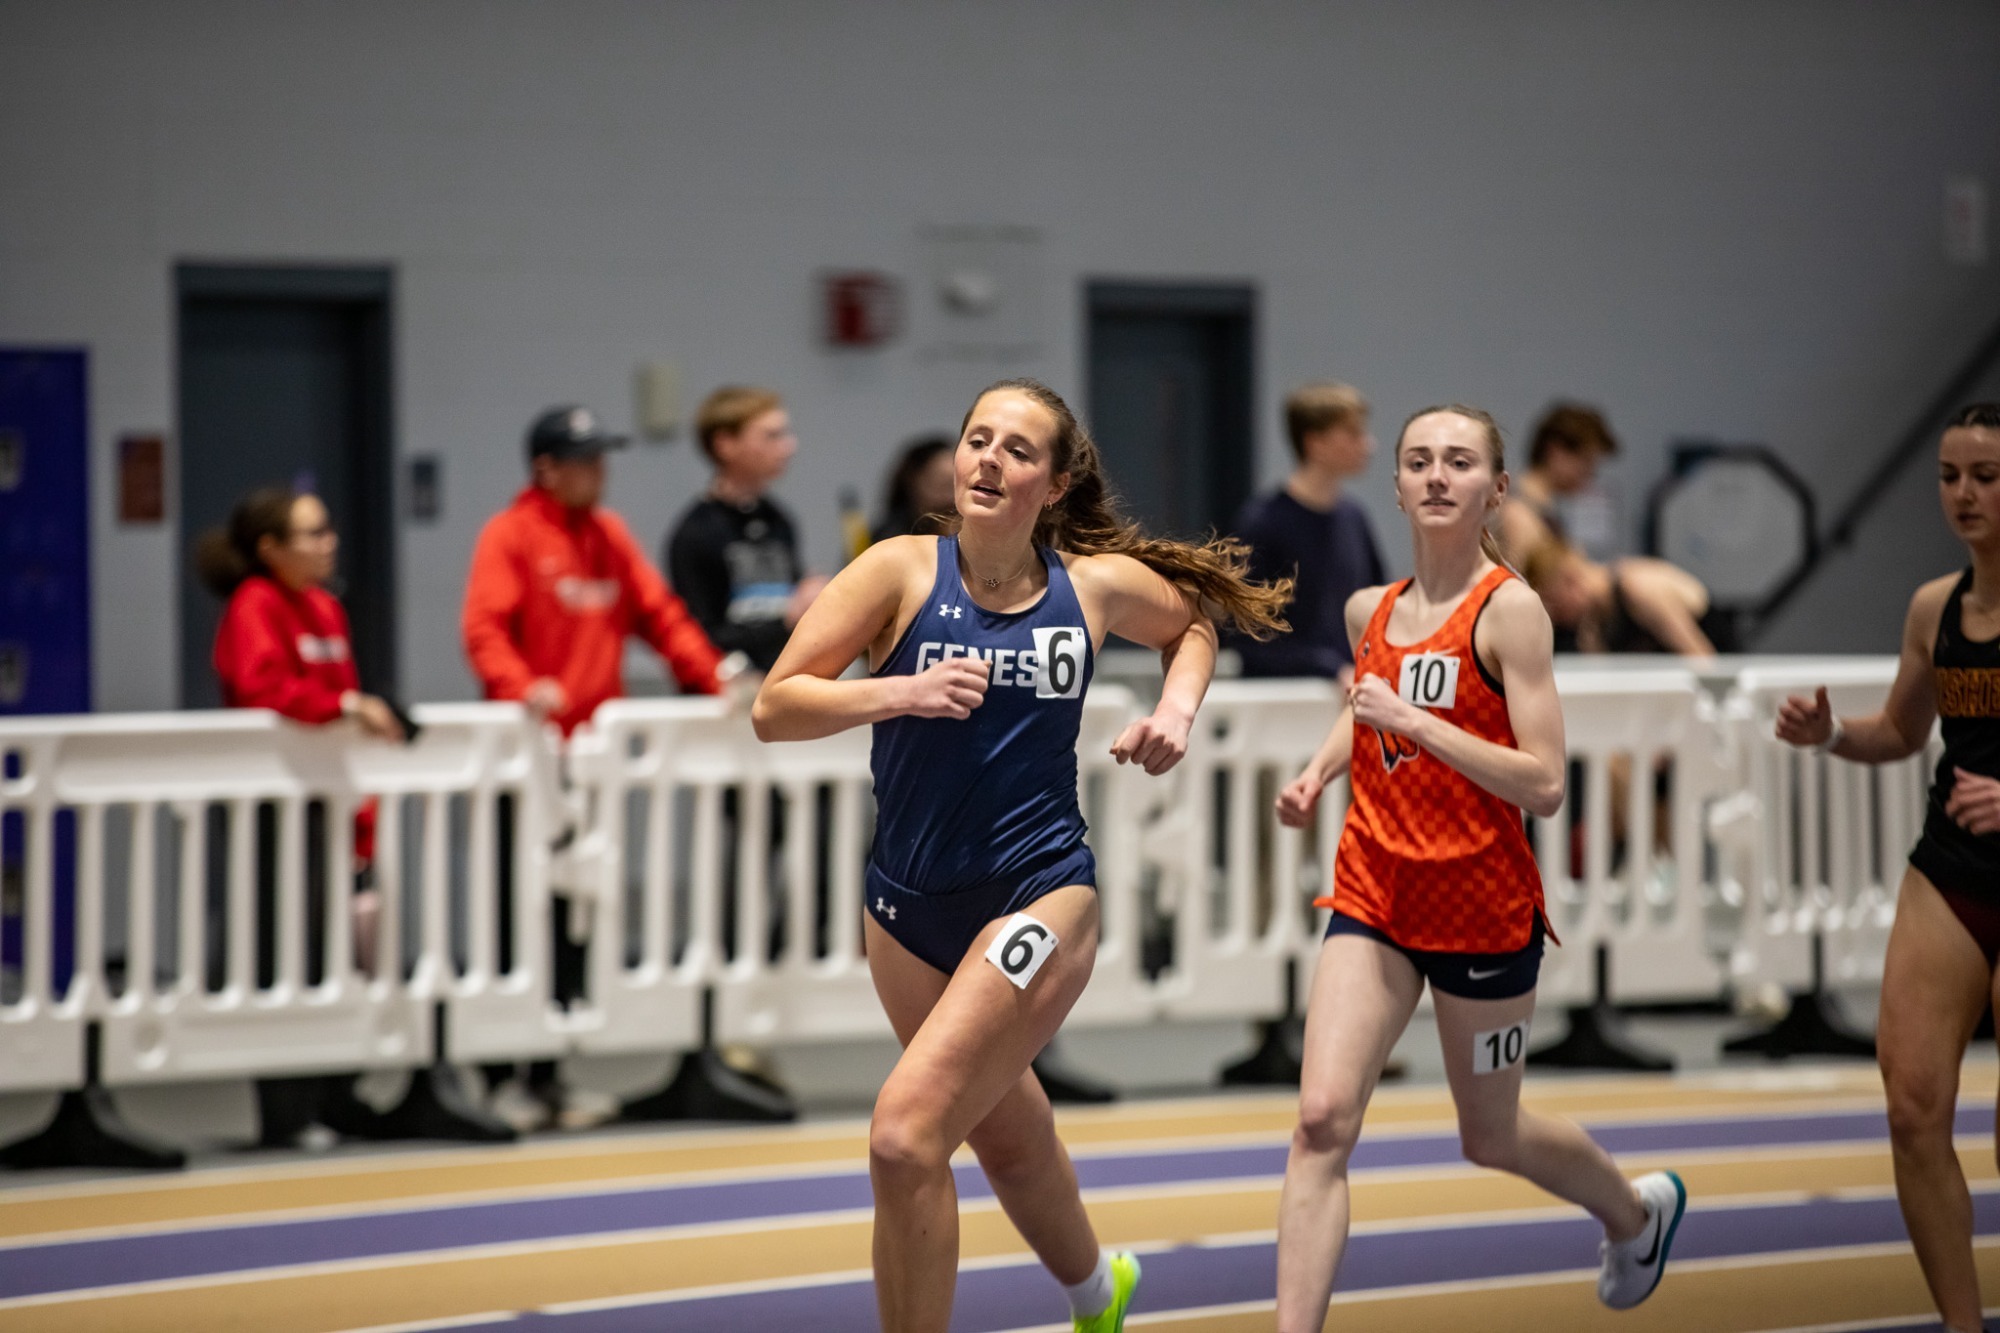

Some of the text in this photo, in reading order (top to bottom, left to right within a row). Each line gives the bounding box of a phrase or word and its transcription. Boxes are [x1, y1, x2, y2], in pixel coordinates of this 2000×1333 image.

[1048, 630, 1076, 695] 6
[1410, 658, 1446, 703] 10
[1001, 923, 1048, 975] 6
[1485, 1026, 1522, 1069] 10
